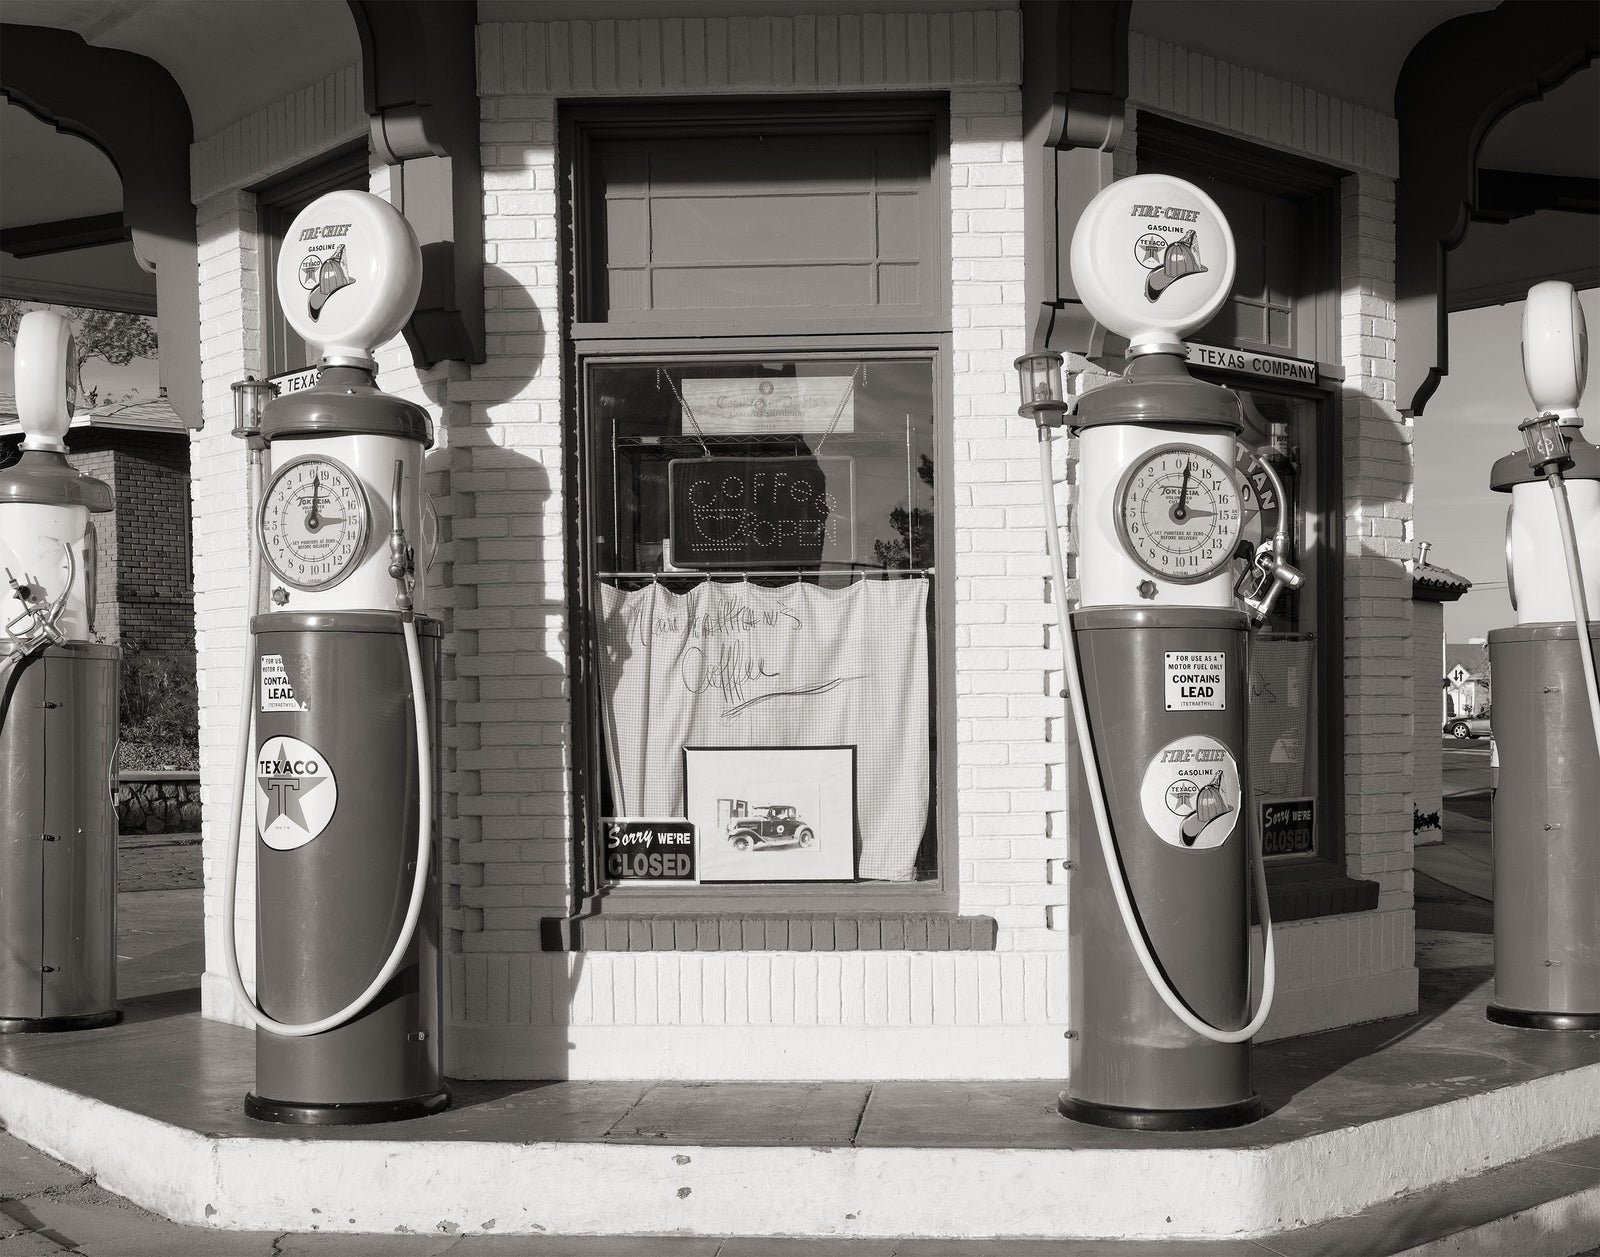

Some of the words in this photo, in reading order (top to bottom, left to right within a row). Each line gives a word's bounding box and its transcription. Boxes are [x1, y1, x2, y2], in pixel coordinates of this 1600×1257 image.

[1131, 204, 1201, 222] FIRE-CHIEF
[298, 223, 352, 241] FIRE-CHIEF
[1147, 224, 1184, 233] GASOLINE
[308, 243, 336, 252] GASOLINE
[1140, 239, 1165, 247] TEXACO
[1199, 348, 1245, 370] TEXAS
[1252, 357, 1315, 380] COMPANY
[287, 371, 322, 392] TEXAS
[1162, 461, 1166, 470] 1
[1176, 459, 1182, 469] 0
[1189, 461, 1199, 471] 19
[310, 470, 315, 479] 0
[320, 470, 329, 480] 19
[1148, 467, 1154, 477] 2
[1202, 469, 1212, 479] 18
[298, 473, 302, 482] 1
[332, 477, 341, 486] 18
[287, 480, 293, 489] 2
[1138, 478, 1144, 488] 3
[1212, 481, 1221, 491] 17
[278, 492, 284, 501] 3
[341, 487, 350, 497] 17
[1130, 492, 1137, 502] 4
[1218, 494, 1229, 504] 16
[272, 505, 278, 515] 4
[347, 500, 356, 510] 16
[1130, 508, 1136, 518] 5
[1219, 510, 1229, 520] 15
[348, 515, 357, 525] 15
[272, 521, 277, 530] 5
[1131, 522, 1139, 532] 6
[1218, 525, 1228, 535] 14
[347, 531, 356, 540] 14
[752, 519, 837, 548] OPEN
[273, 535, 279, 545] 6
[1138, 538, 1145, 548] 7
[1212, 539, 1223, 549] 13
[279, 549, 284, 558] 7
[342, 544, 351, 554] 13
[1149, 548, 1156, 559] 8
[1201, 549, 1213, 559] 12
[287, 558, 294, 569] 8
[333, 556, 343, 565] 12
[1162, 555, 1169, 565] 9
[1175, 557, 1185, 567] 10
[1189, 556, 1198, 566] 11
[298, 564, 305, 574] 9
[310, 565, 319, 575] 10
[322, 563, 330, 573] 11
[1172, 674, 1220, 684] CONTAINS
[268, 688, 295, 699] LEAD
[1181, 686, 1214, 698] LEAD
[1161, 748, 1226, 763] FIRE-CHIEF
[260, 760, 319, 775] TEXACO
[1178, 769, 1213, 777] GASOLINE
[1264, 807, 1291, 829] Sorry
[1292, 809, 1312, 822] WE'RE
[607, 826, 654, 849] Sorry
[657, 832, 691, 845] WE'RE
[1264, 828, 1311, 852] CLOSED
[608, 853, 691, 877] CLOSED
